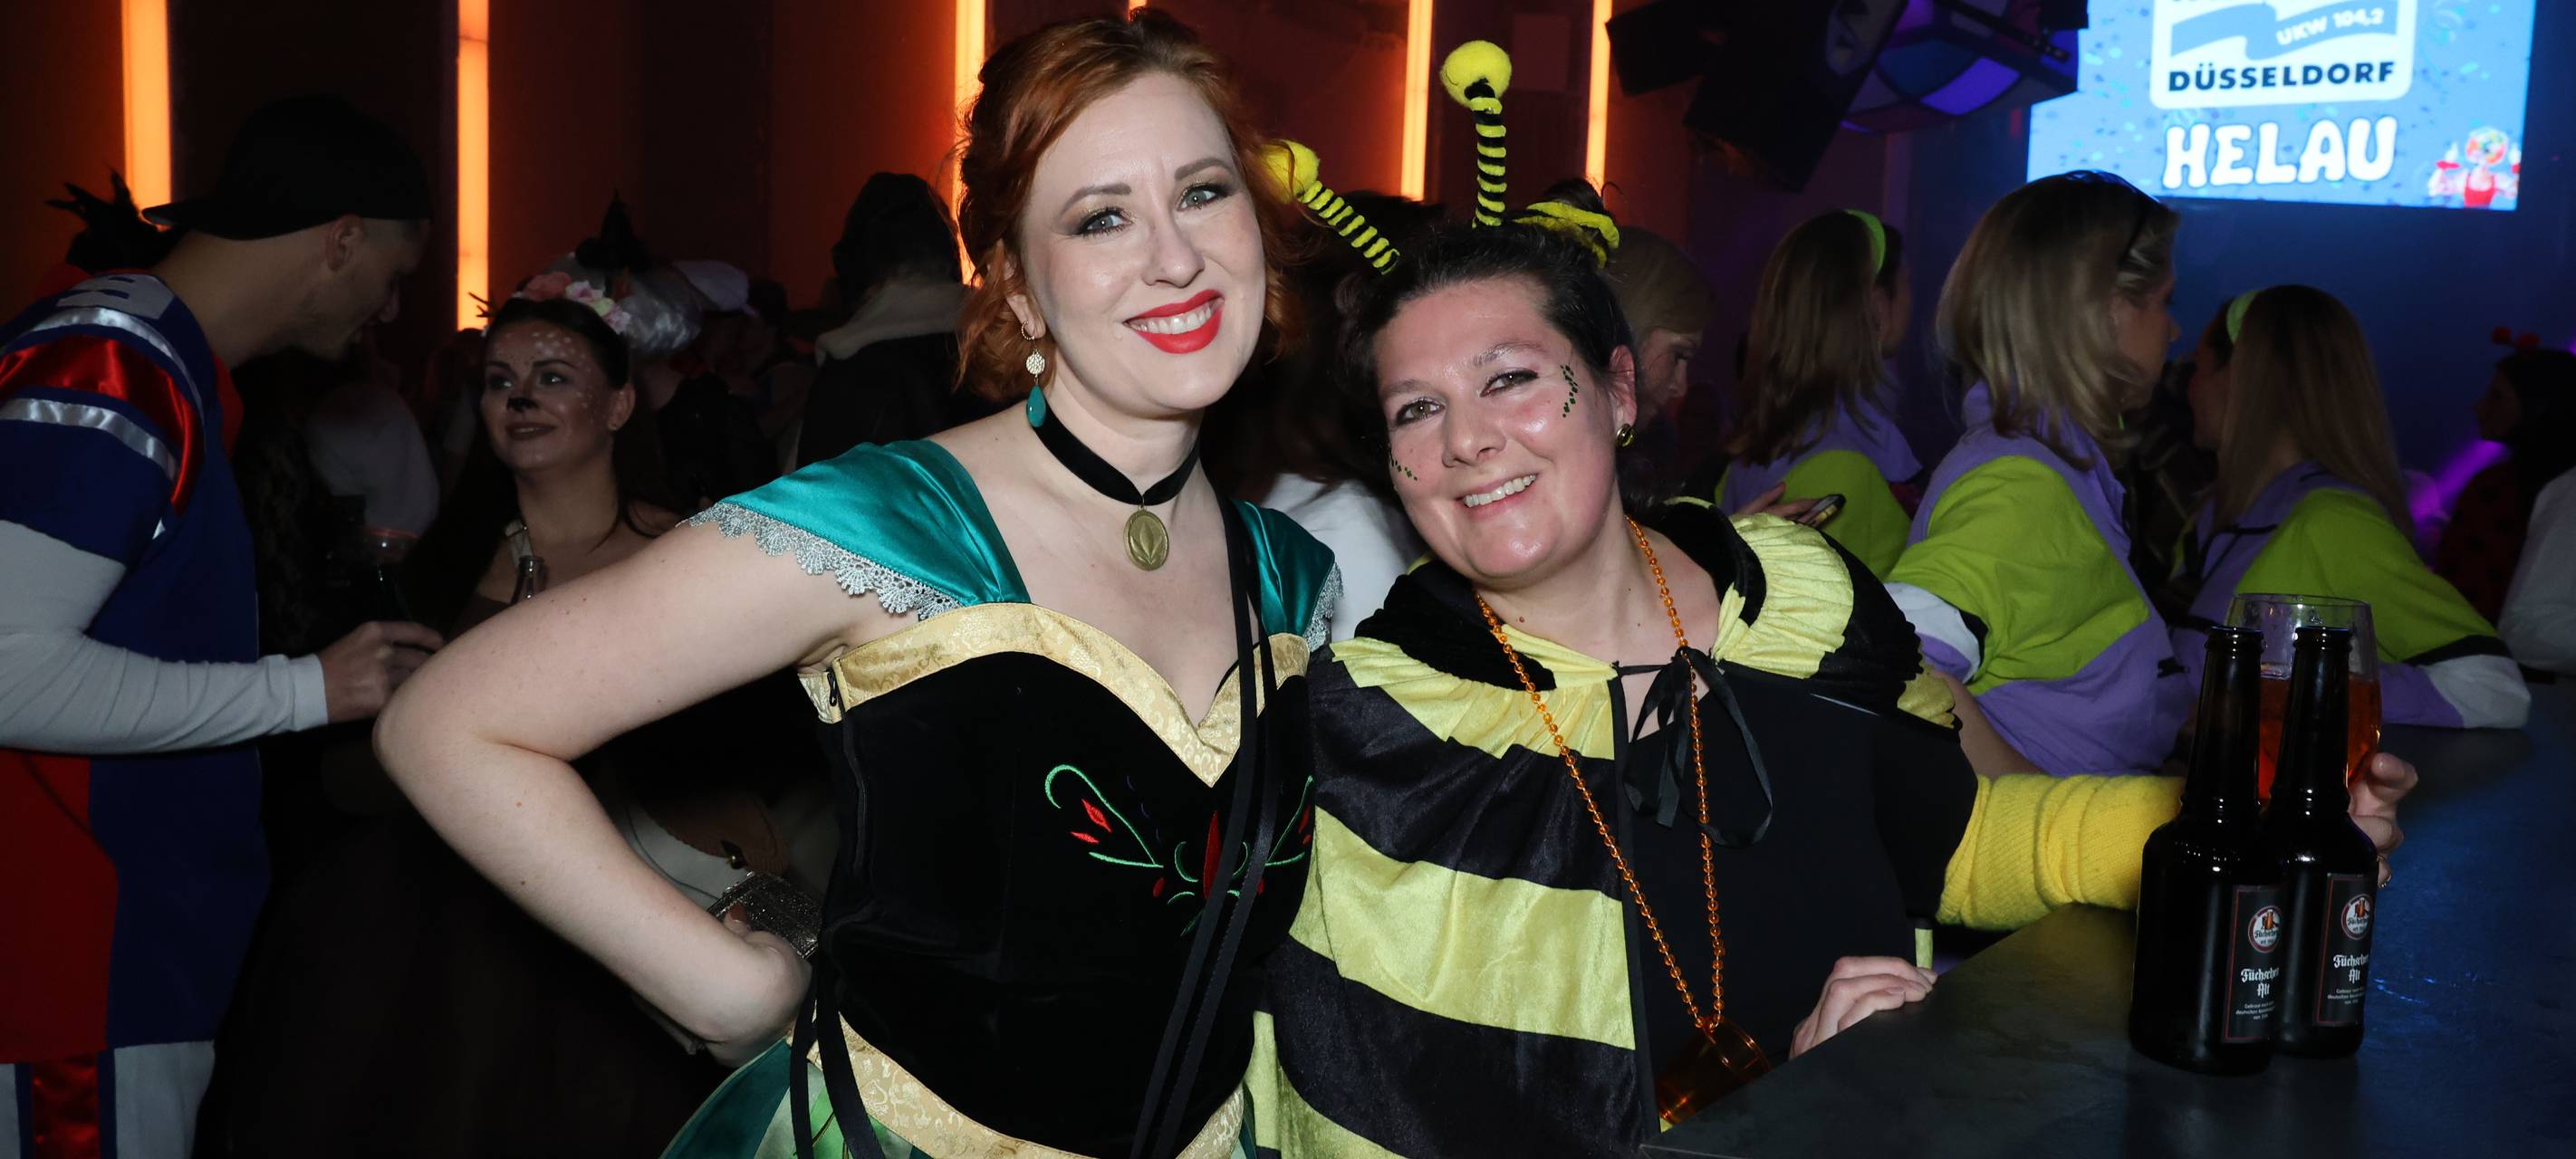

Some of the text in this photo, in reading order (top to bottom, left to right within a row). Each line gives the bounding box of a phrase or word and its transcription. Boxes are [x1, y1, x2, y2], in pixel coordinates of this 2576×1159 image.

[2275, 15, 2328, 45] UKW
[2168, 61, 2394, 91] DÜSSELDORF
[2162, 116, 2398, 189] HELAU
[2256, 982, 2271, 999] Alt
